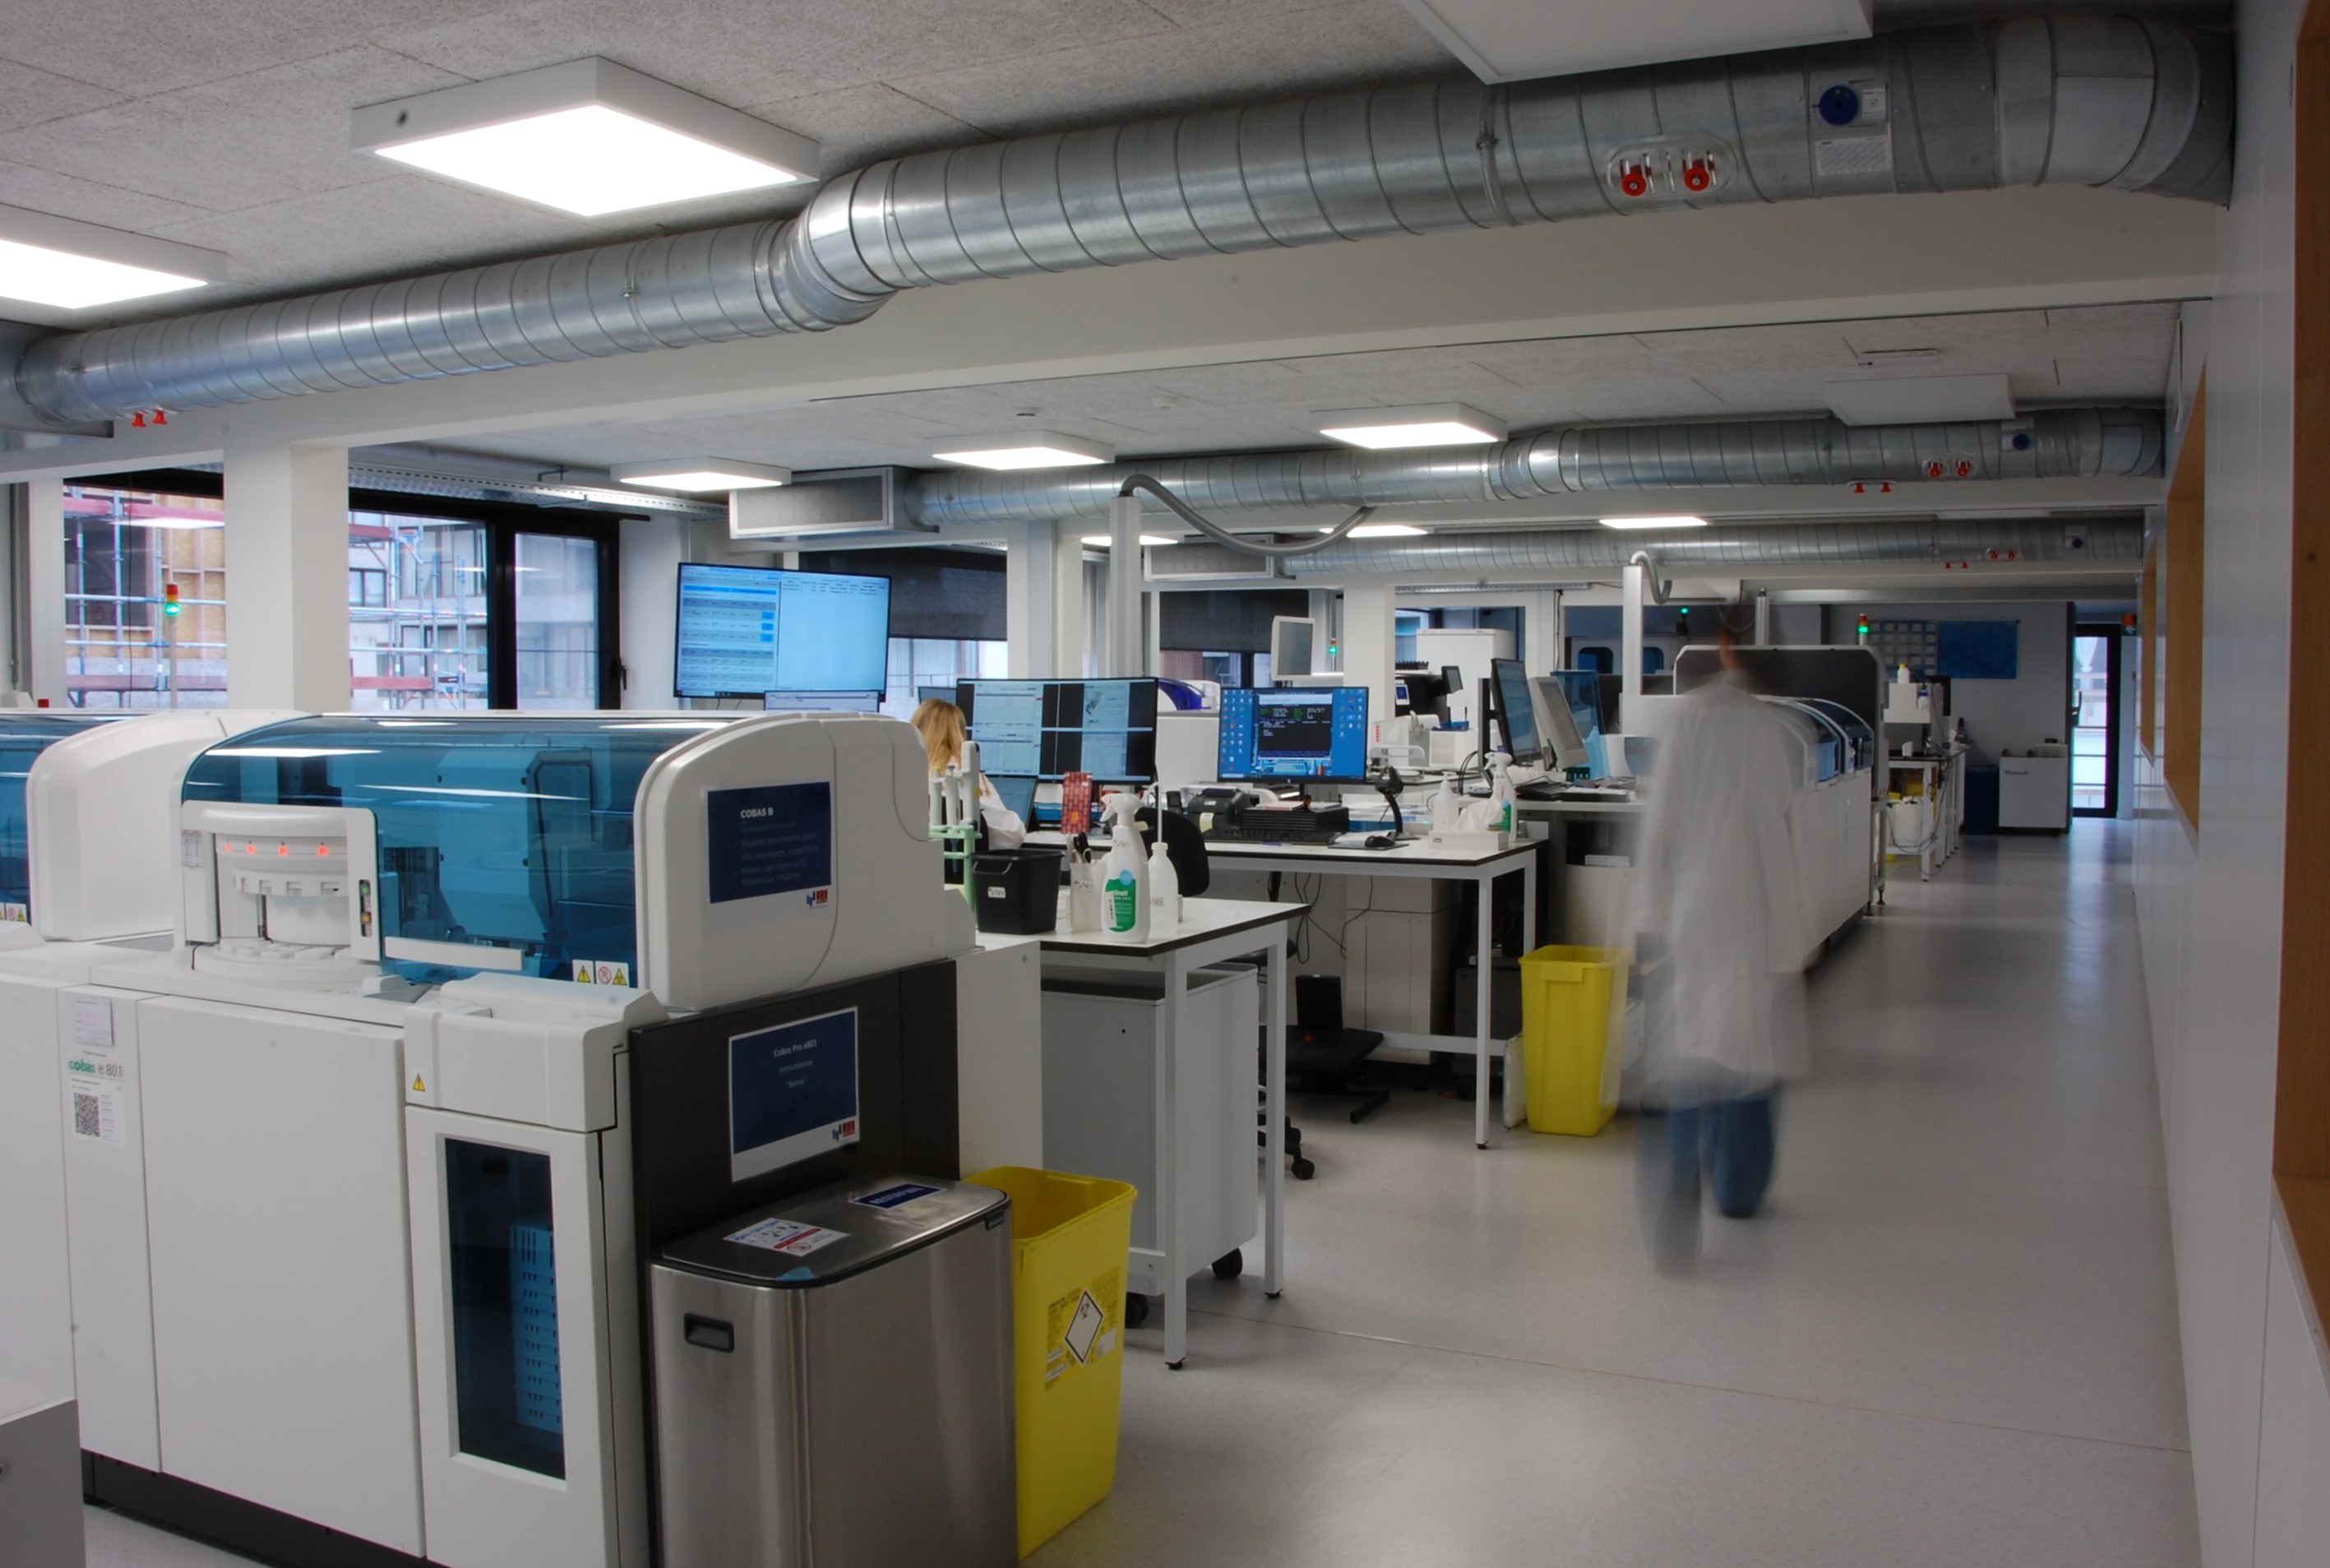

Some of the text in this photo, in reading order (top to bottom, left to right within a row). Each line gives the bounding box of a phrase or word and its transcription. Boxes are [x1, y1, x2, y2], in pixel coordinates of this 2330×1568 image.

[740, 807, 774, 818] COBAS B
[774, 1047, 792, 1057] Cobas
[792, 1043, 802, 1052] Pro
[68, 1059, 123, 1078] cobas e 801
